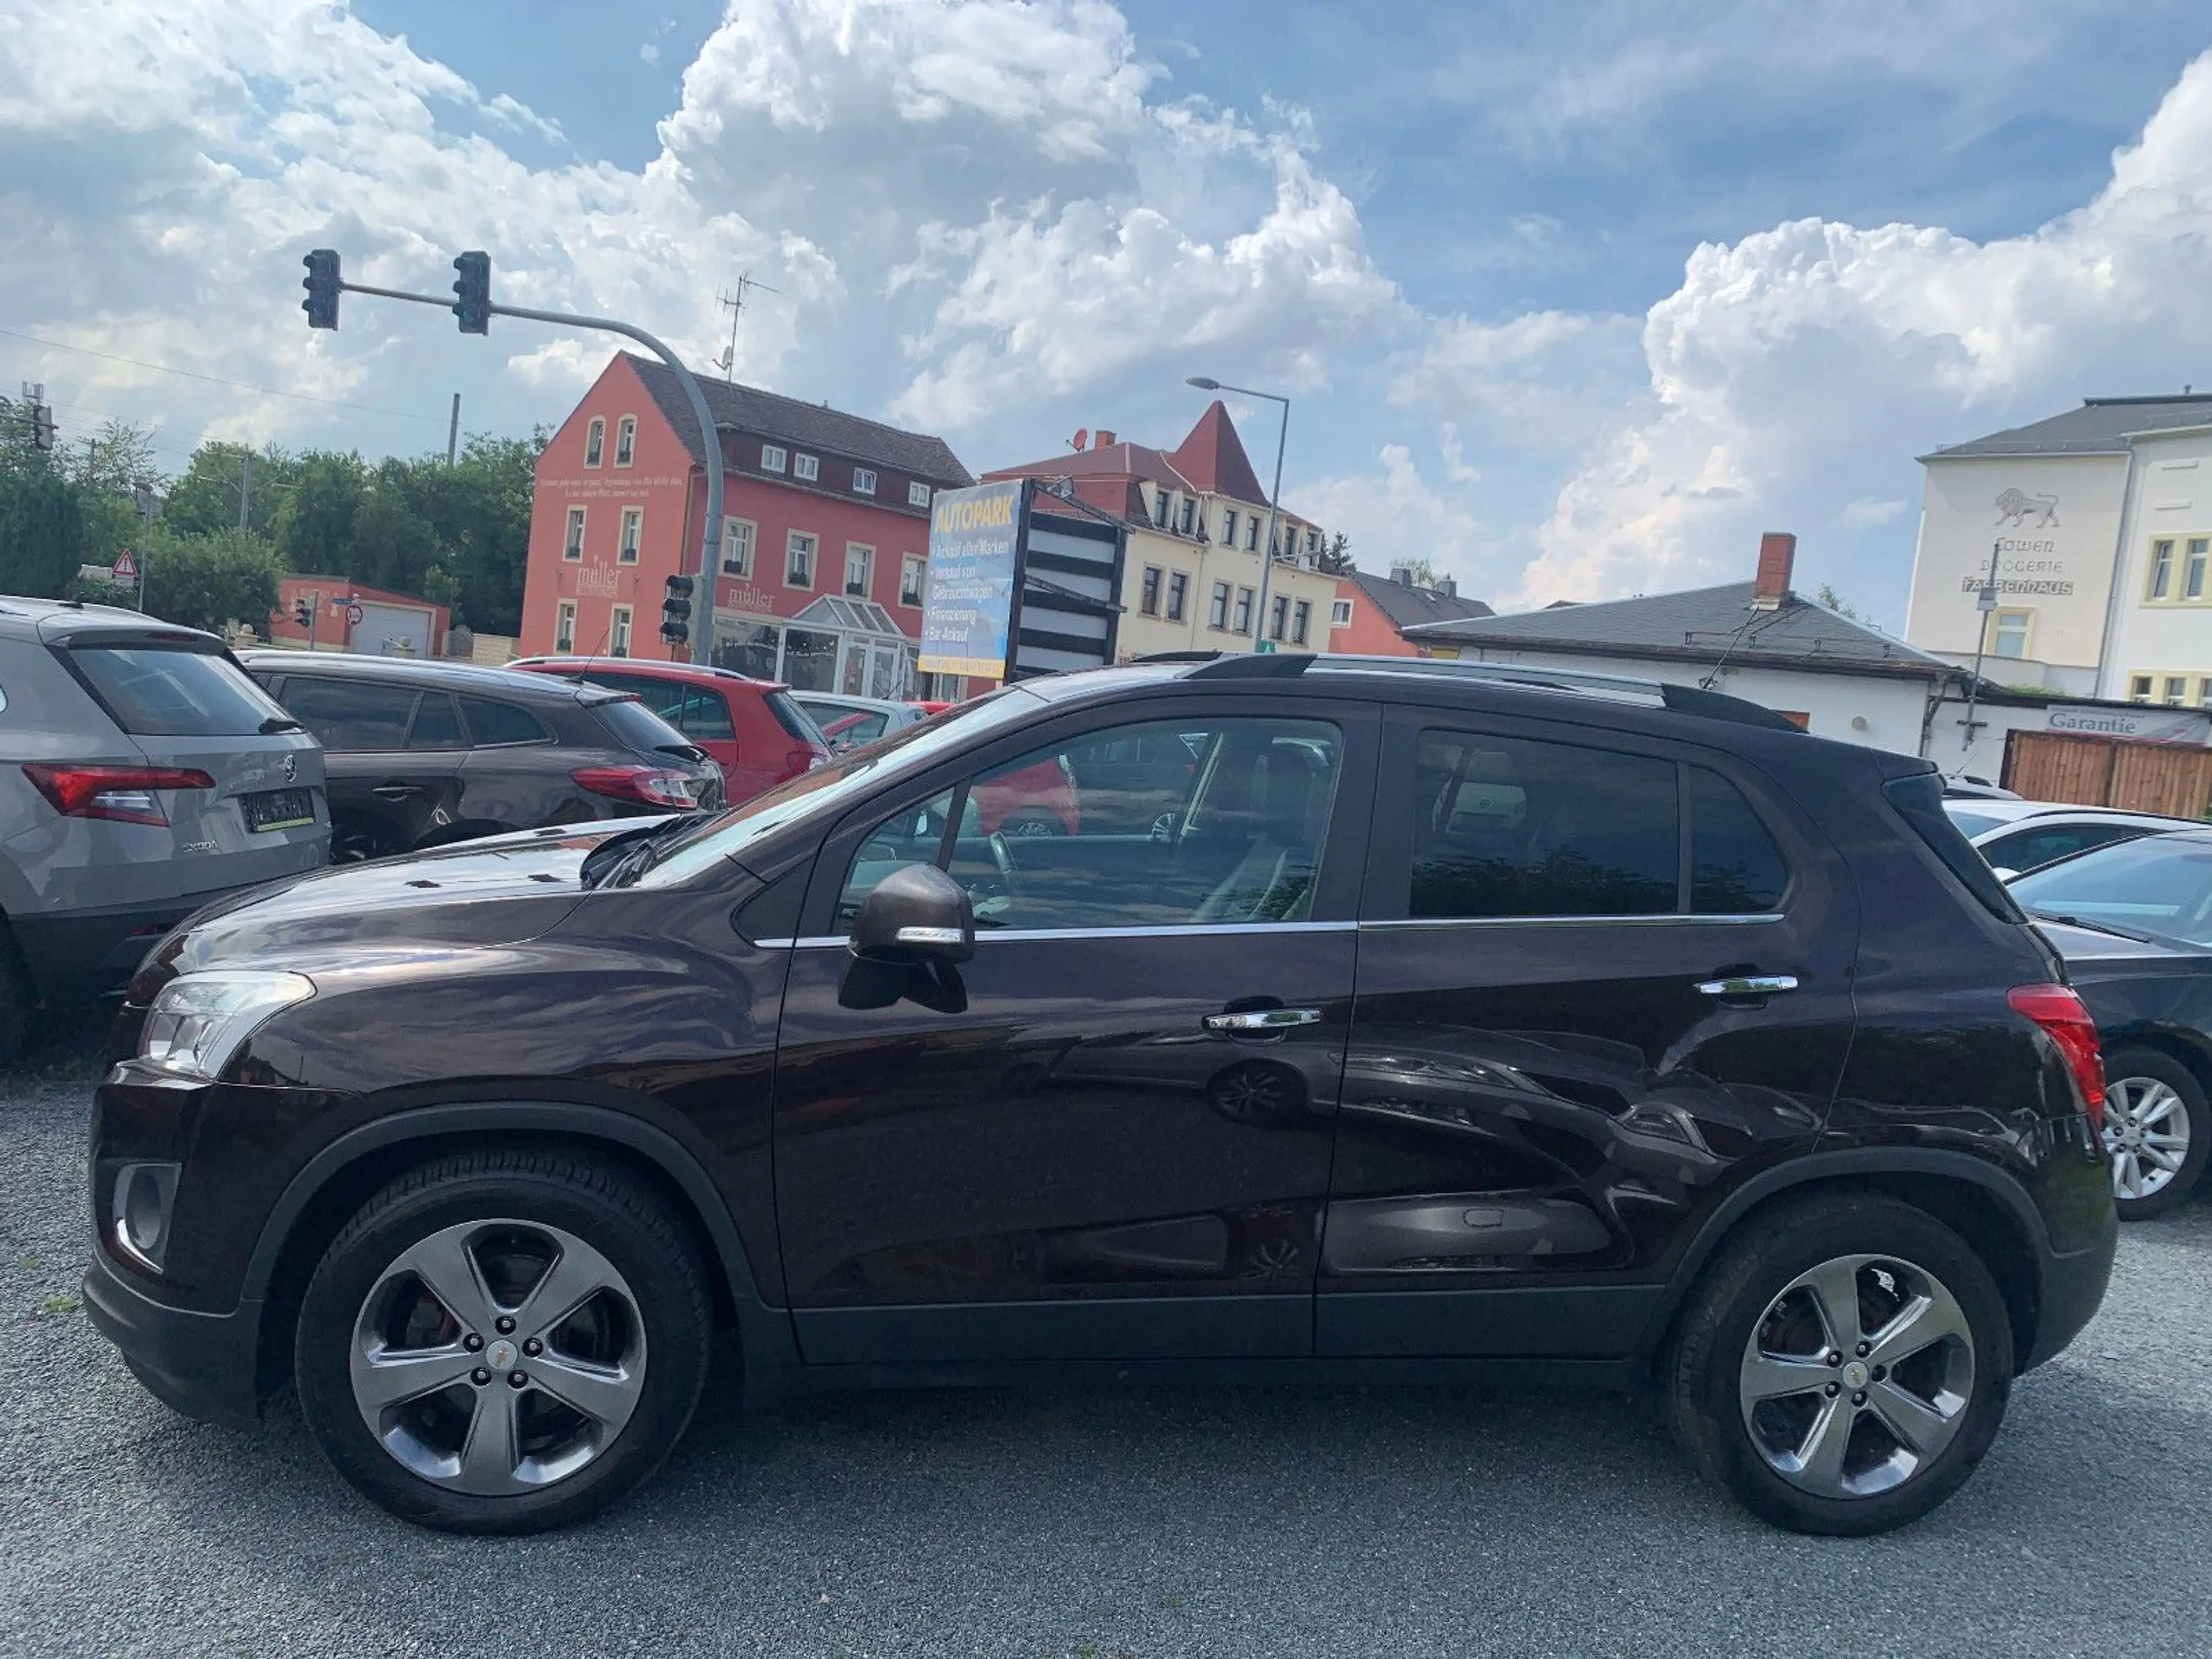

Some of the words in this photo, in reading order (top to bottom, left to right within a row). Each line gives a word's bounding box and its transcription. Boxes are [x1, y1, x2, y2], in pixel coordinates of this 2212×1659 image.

[934, 495, 1014, 534] AUTOPARK
[980, 537, 1009, 555] Marken
[2050, 713, 2136, 734] Garantie
